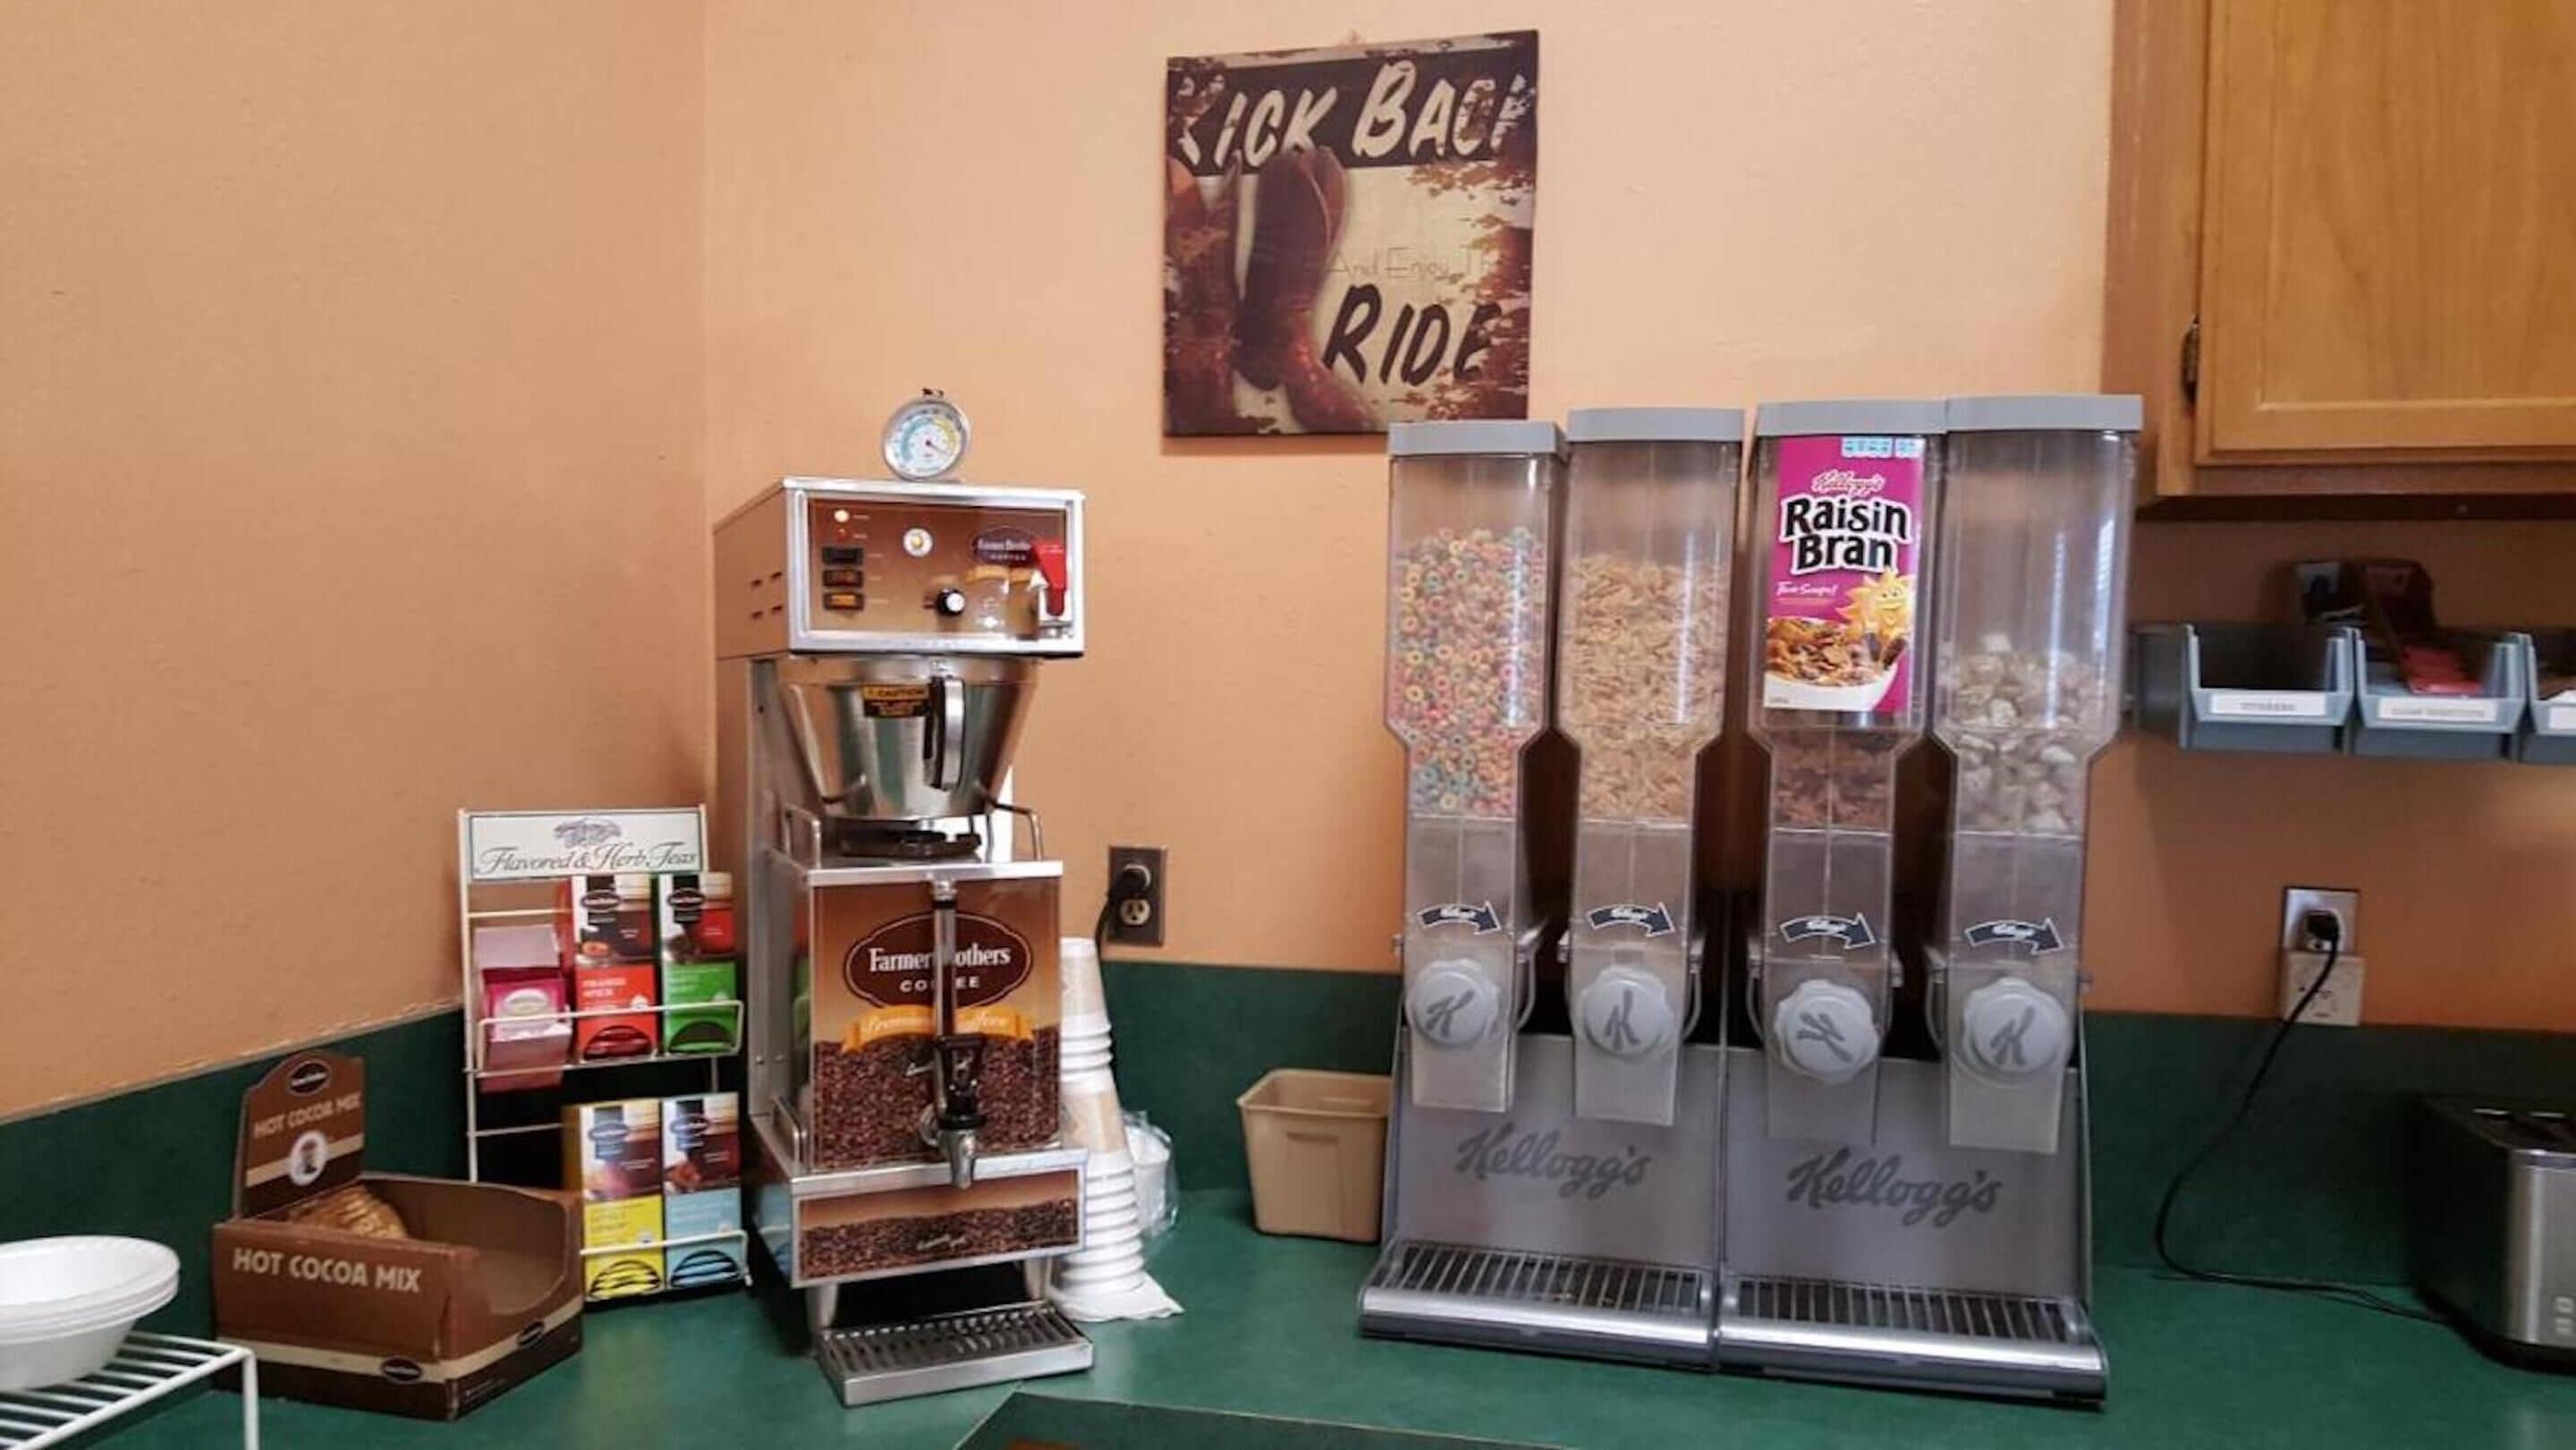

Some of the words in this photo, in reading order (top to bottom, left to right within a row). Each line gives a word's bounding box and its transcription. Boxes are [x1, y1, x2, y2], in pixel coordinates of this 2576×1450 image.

[1321, 284, 1501, 387] RIDE
[1784, 497, 1907, 538] Raisin
[1796, 534, 1893, 571] Bran
[474, 845, 575, 875] Flavored
[645, 842, 699, 869] Teas
[869, 947, 931, 972] Farmer
[934, 942, 1012, 968] others
[899, 975, 980, 993] COEE
[253, 1115, 285, 1139] HOT
[288, 1099, 333, 1128] COCOA
[336, 1092, 362, 1114] MIX
[1454, 1122, 1652, 1200] Kellogg's
[1786, 1145, 2004, 1229] Kellogg's
[233, 1248, 284, 1276] HOT
[288, 1255, 369, 1287] COCOA
[374, 1264, 422, 1293] MIX
